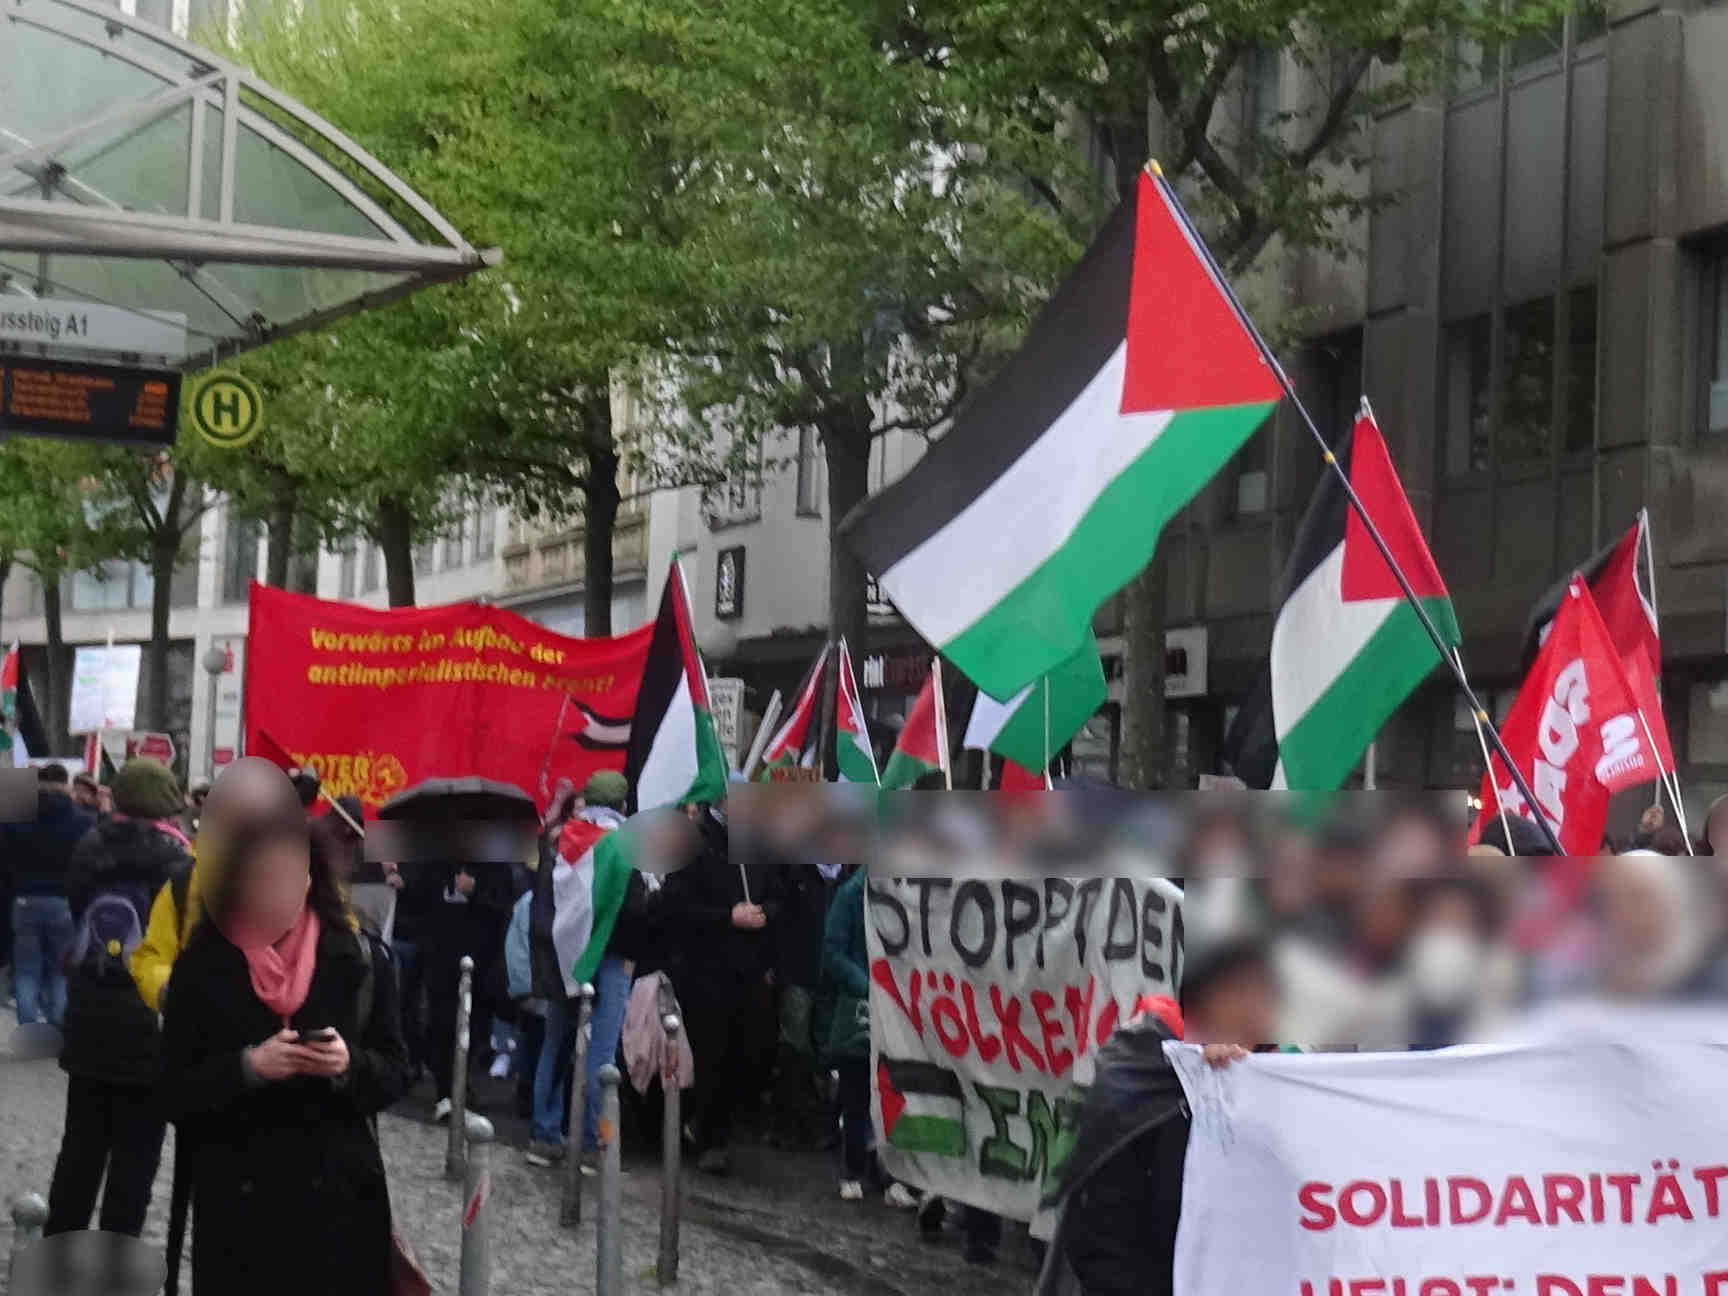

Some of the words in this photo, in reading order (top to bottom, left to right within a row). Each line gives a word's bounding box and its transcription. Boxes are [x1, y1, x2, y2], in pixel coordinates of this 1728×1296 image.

[65, 313, 88, 337] A1
[212, 390, 241, 427] H
[530, 642, 567, 665] der
[867, 877, 1102, 971] STOPPT
